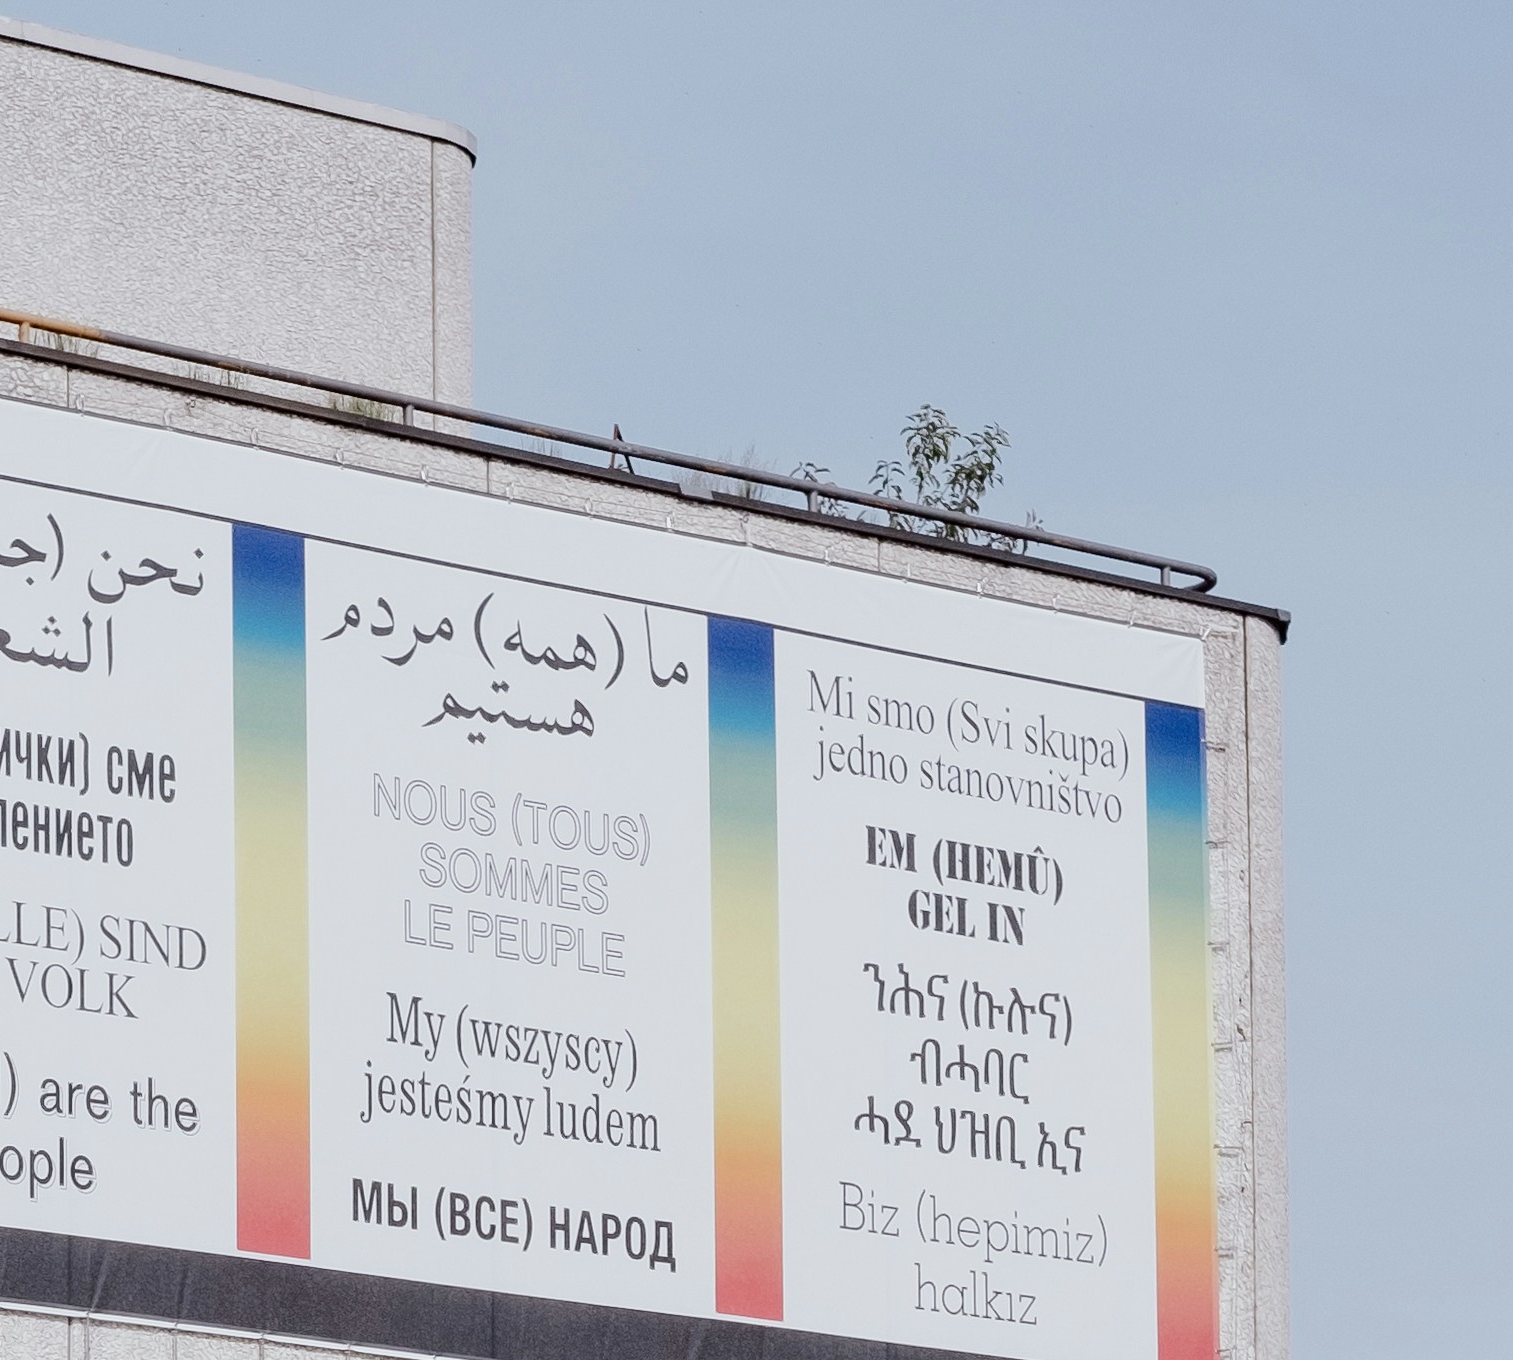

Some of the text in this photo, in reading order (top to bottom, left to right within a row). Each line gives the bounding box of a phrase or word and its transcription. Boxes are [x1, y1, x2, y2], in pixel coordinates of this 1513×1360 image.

[88, 548, 204, 604] نحن
[320, 597, 454, 666] مردم
[643, 606, 689, 688] ما
[806, 668, 1129, 782] Mi smo (Svi skupa)
[106, 745, 177, 803] сме
[813, 726, 1123, 824] jedno stanovništvo
[373, 772, 651, 867] NOUS (TOUS)
[419, 842, 609, 915] SOMMES
[865, 825, 1064, 907] EM (HEMÛ)
[99, 914, 207, 971] SIND
[404, 899, 627, 979] LE PEUPLE
[908, 888, 1025, 946] GEL IN
[4, 957, 140, 1019] VOLK
[386, 991, 638, 1093] My (wszyscy)
[39, 1078, 112, 1123] are
[129, 1077, 201, 1134] the
[360, 1059, 661, 1152] jesteśmy ludem
[352, 1177, 676, 1273] МЫ (ВСЕ) НАРОД
[839, 1181, 1108, 1268] Biz (hepimiz)
[914, 1262, 1038, 1326] halkız
